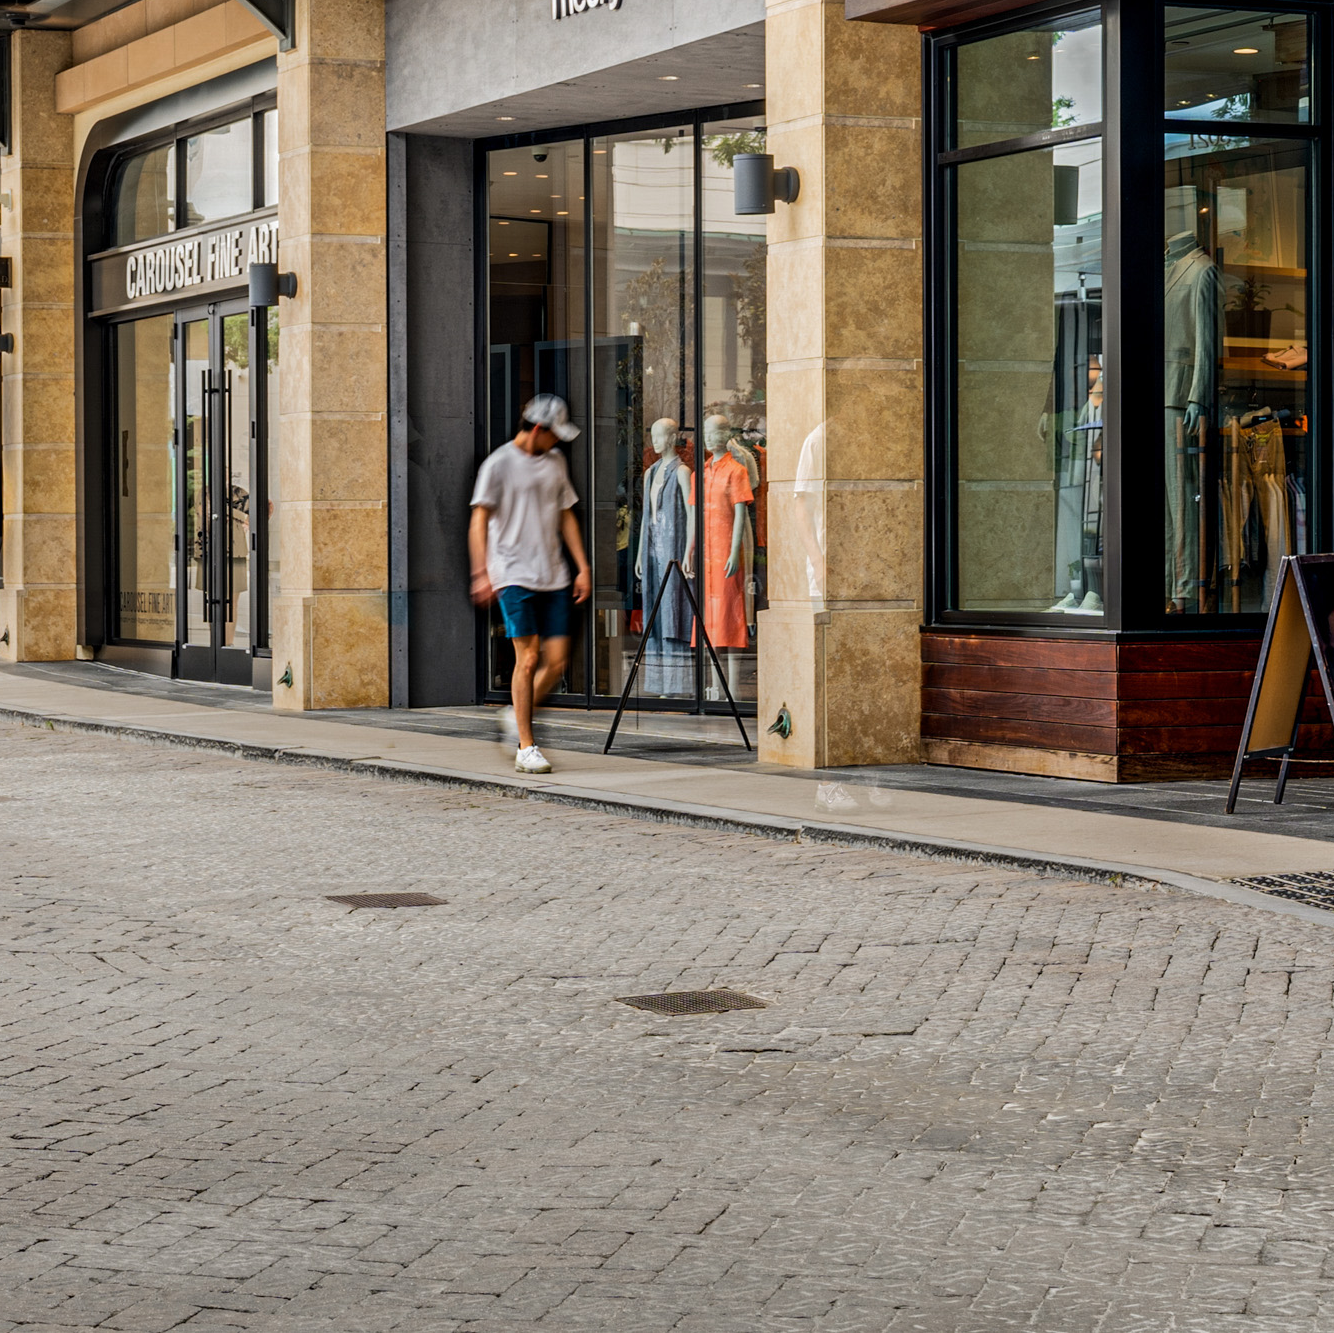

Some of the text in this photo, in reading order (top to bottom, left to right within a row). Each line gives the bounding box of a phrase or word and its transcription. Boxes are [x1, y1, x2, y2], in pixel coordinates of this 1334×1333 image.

[126, 219, 280, 300] CAROUSEL FINE ART
[119, 591, 147, 612] CAROUSEL
[148, 592, 161, 613] FINE
